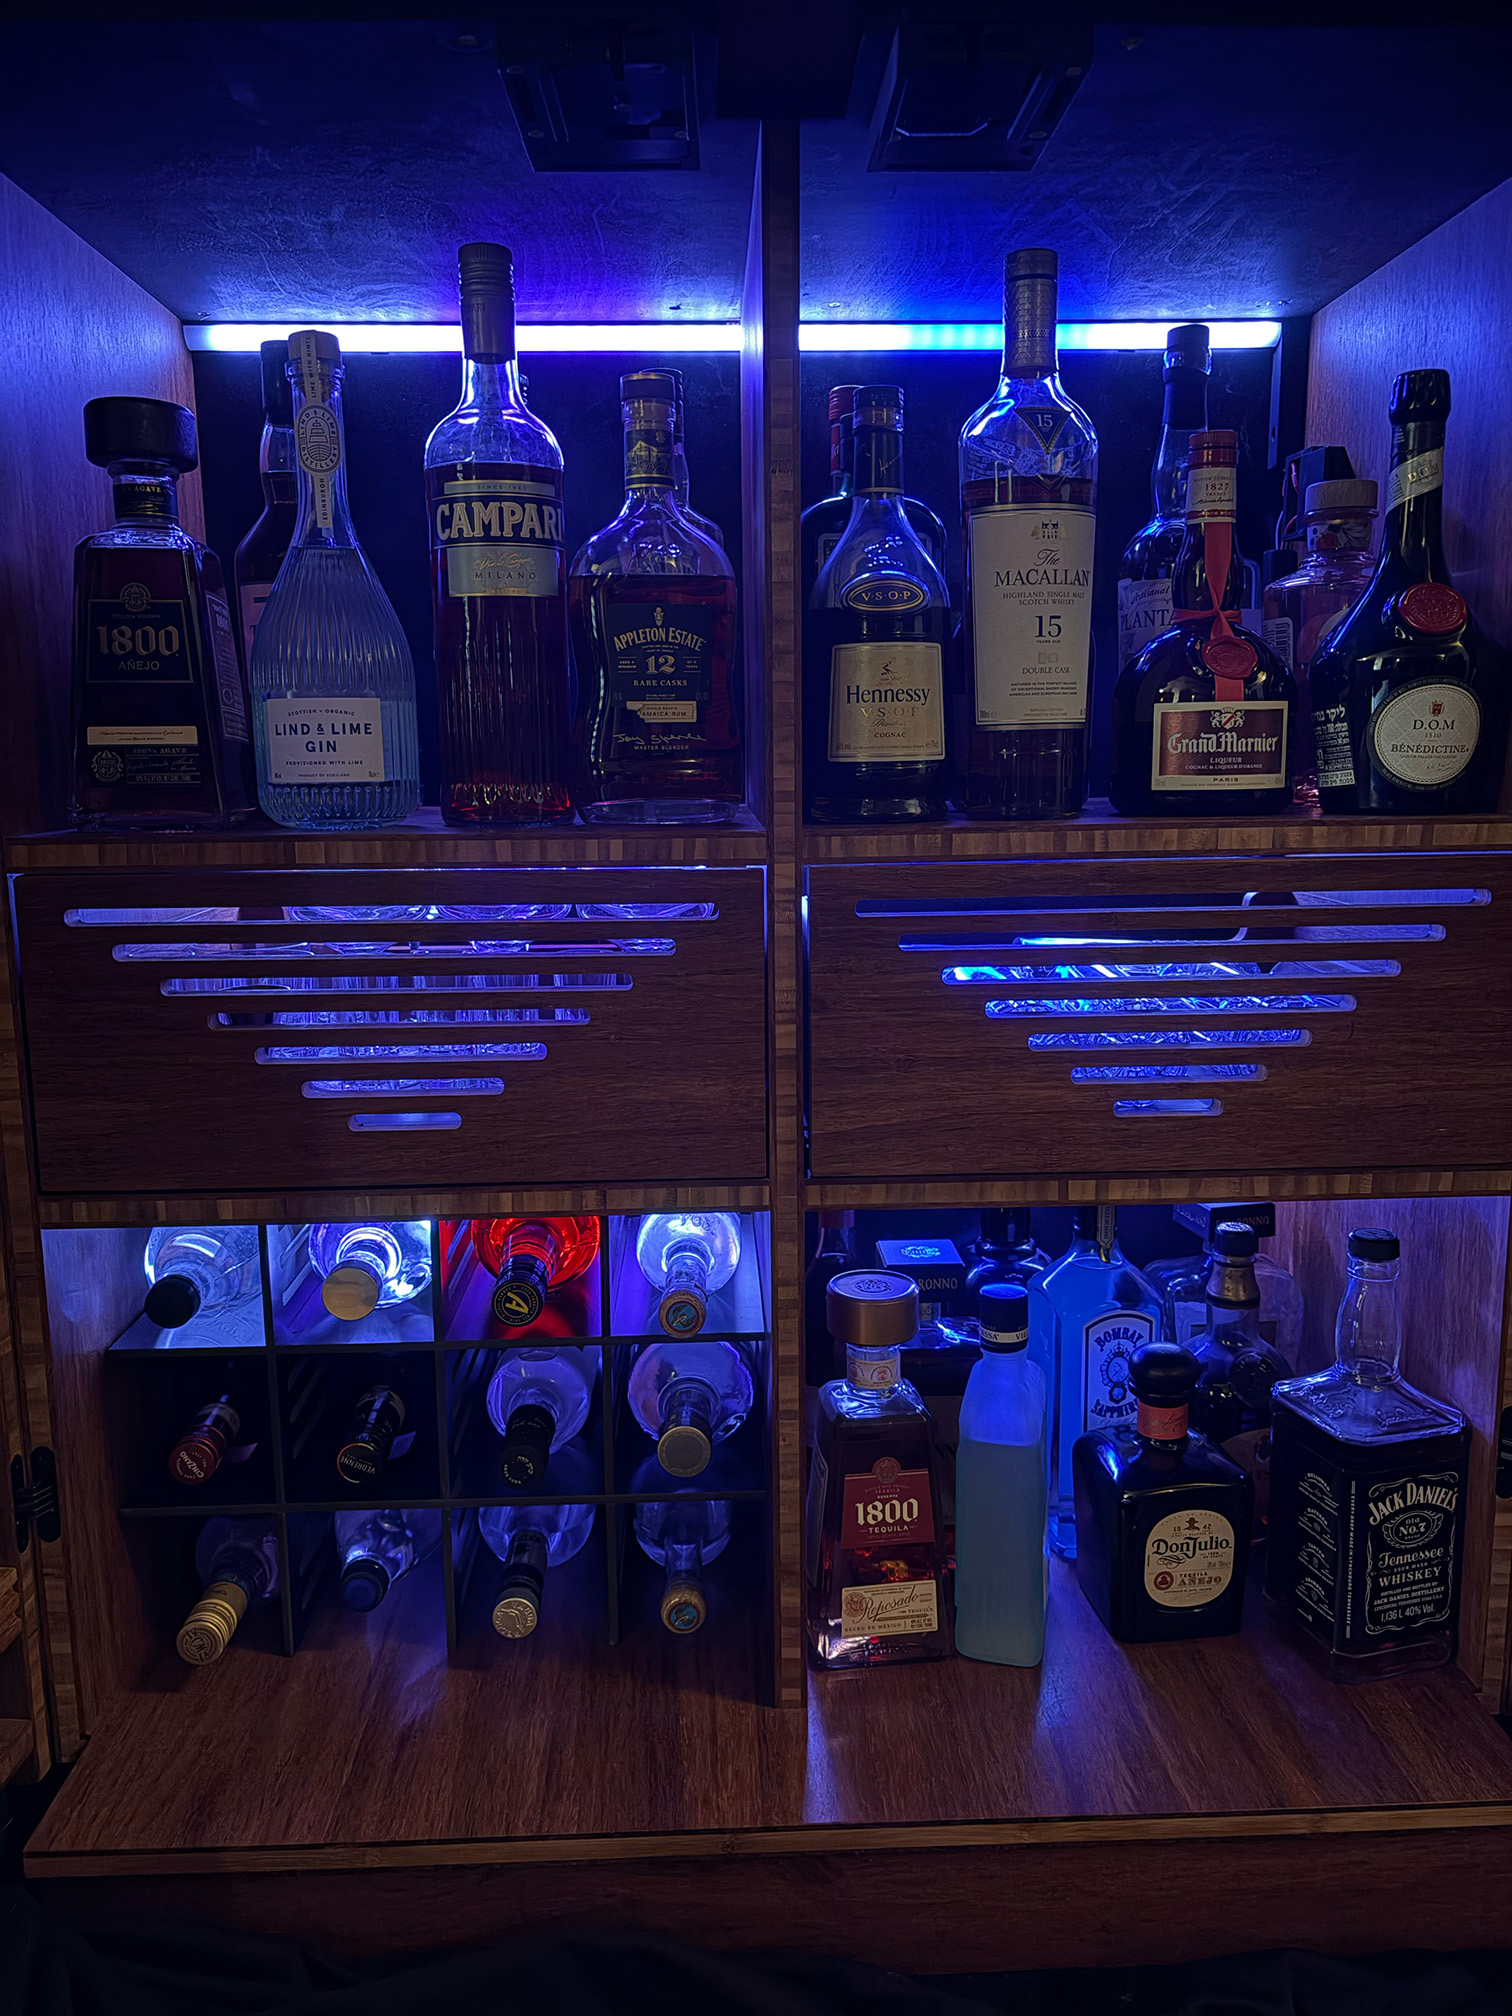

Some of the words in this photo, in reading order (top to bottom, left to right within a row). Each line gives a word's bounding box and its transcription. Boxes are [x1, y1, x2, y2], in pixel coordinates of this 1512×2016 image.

[1036, 414, 1054, 428] 15
[133, 485, 162, 493] AGAVE
[1205, 482, 1229, 491] 1827
[436, 501, 563, 541] CAMPARI
[1033, 549, 1061, 567] The
[474, 571, 536, 580] MILANO
[993, 568, 1091, 588] MACALLAN
[1002, 591, 1045, 600] HIGHLAND
[1046, 591, 1071, 599] SINGLE
[1018, 598, 1050, 606] SCOTCH
[1051, 598, 1076, 606] WHISKY
[1034, 615, 1063, 638] 15
[96, 625, 180, 656] 1800
[613, 627, 666, 653] APPLETON
[668, 626, 703, 652] ESTATE
[117, 658, 160, 671] AÑEJO
[645, 654, 677, 675] 12
[1022, 667, 1053, 675] DOUBLE
[1054, 666, 1071, 674] CASK
[633, 679, 658, 687] RARE
[659, 679, 688, 687] CASKS
[846, 685, 931, 706] Hennessy
[287, 709, 317, 717] SCOTTISH
[325, 708, 356, 717] ORGANIC
[274, 723, 311, 736] LIND
[316, 723, 325, 735] &
[331, 722, 373, 735] LIME
[1412, 719, 1456, 731] D.O.M
[305, 740, 337, 753] GIN
[1167, 732, 1217, 754] Grand
[1215, 731, 1279, 754] Marnier
[1391, 742, 1467, 754] BÉNÉDICTINE
[1210, 757, 1243, 765] LIQUEUR
[917, 1277, 959, 1291] RONNO
[505, 1291, 529, 1314] A
[1094, 1327, 1145, 1352] BOMBAY
[180, 1450, 205, 1479] CINZANO
[340, 1455, 377, 1475] VEDRENNE
[1368, 1490, 1406, 1526] JACK
[1406, 1482, 1460, 1513] DANIEL'S
[854, 1498, 919, 1526] 1800
[1405, 1516, 1421, 1525] Old
[868, 1525, 909, 1534] TEQUILA
[1378, 1547, 1444, 1569] Tennessee
[1393, 1565, 1410, 1573] SOUR
[1177, 1575, 1222, 1588] AÑEJO
[1378, 1565, 1442, 1588] WHISKEY
[1373, 1598, 1389, 1606] JACK
[1388, 1593, 1410, 1602] DANIEL
[1410, 1585, 1445, 1598] DISTILLERY
[851, 1584, 920, 1625] Reposado
[907, 1606, 934, 1614] TEQUILA
[1404, 1604, 1422, 1617] 40%
[1422, 1602, 1436, 1614] Vol.
